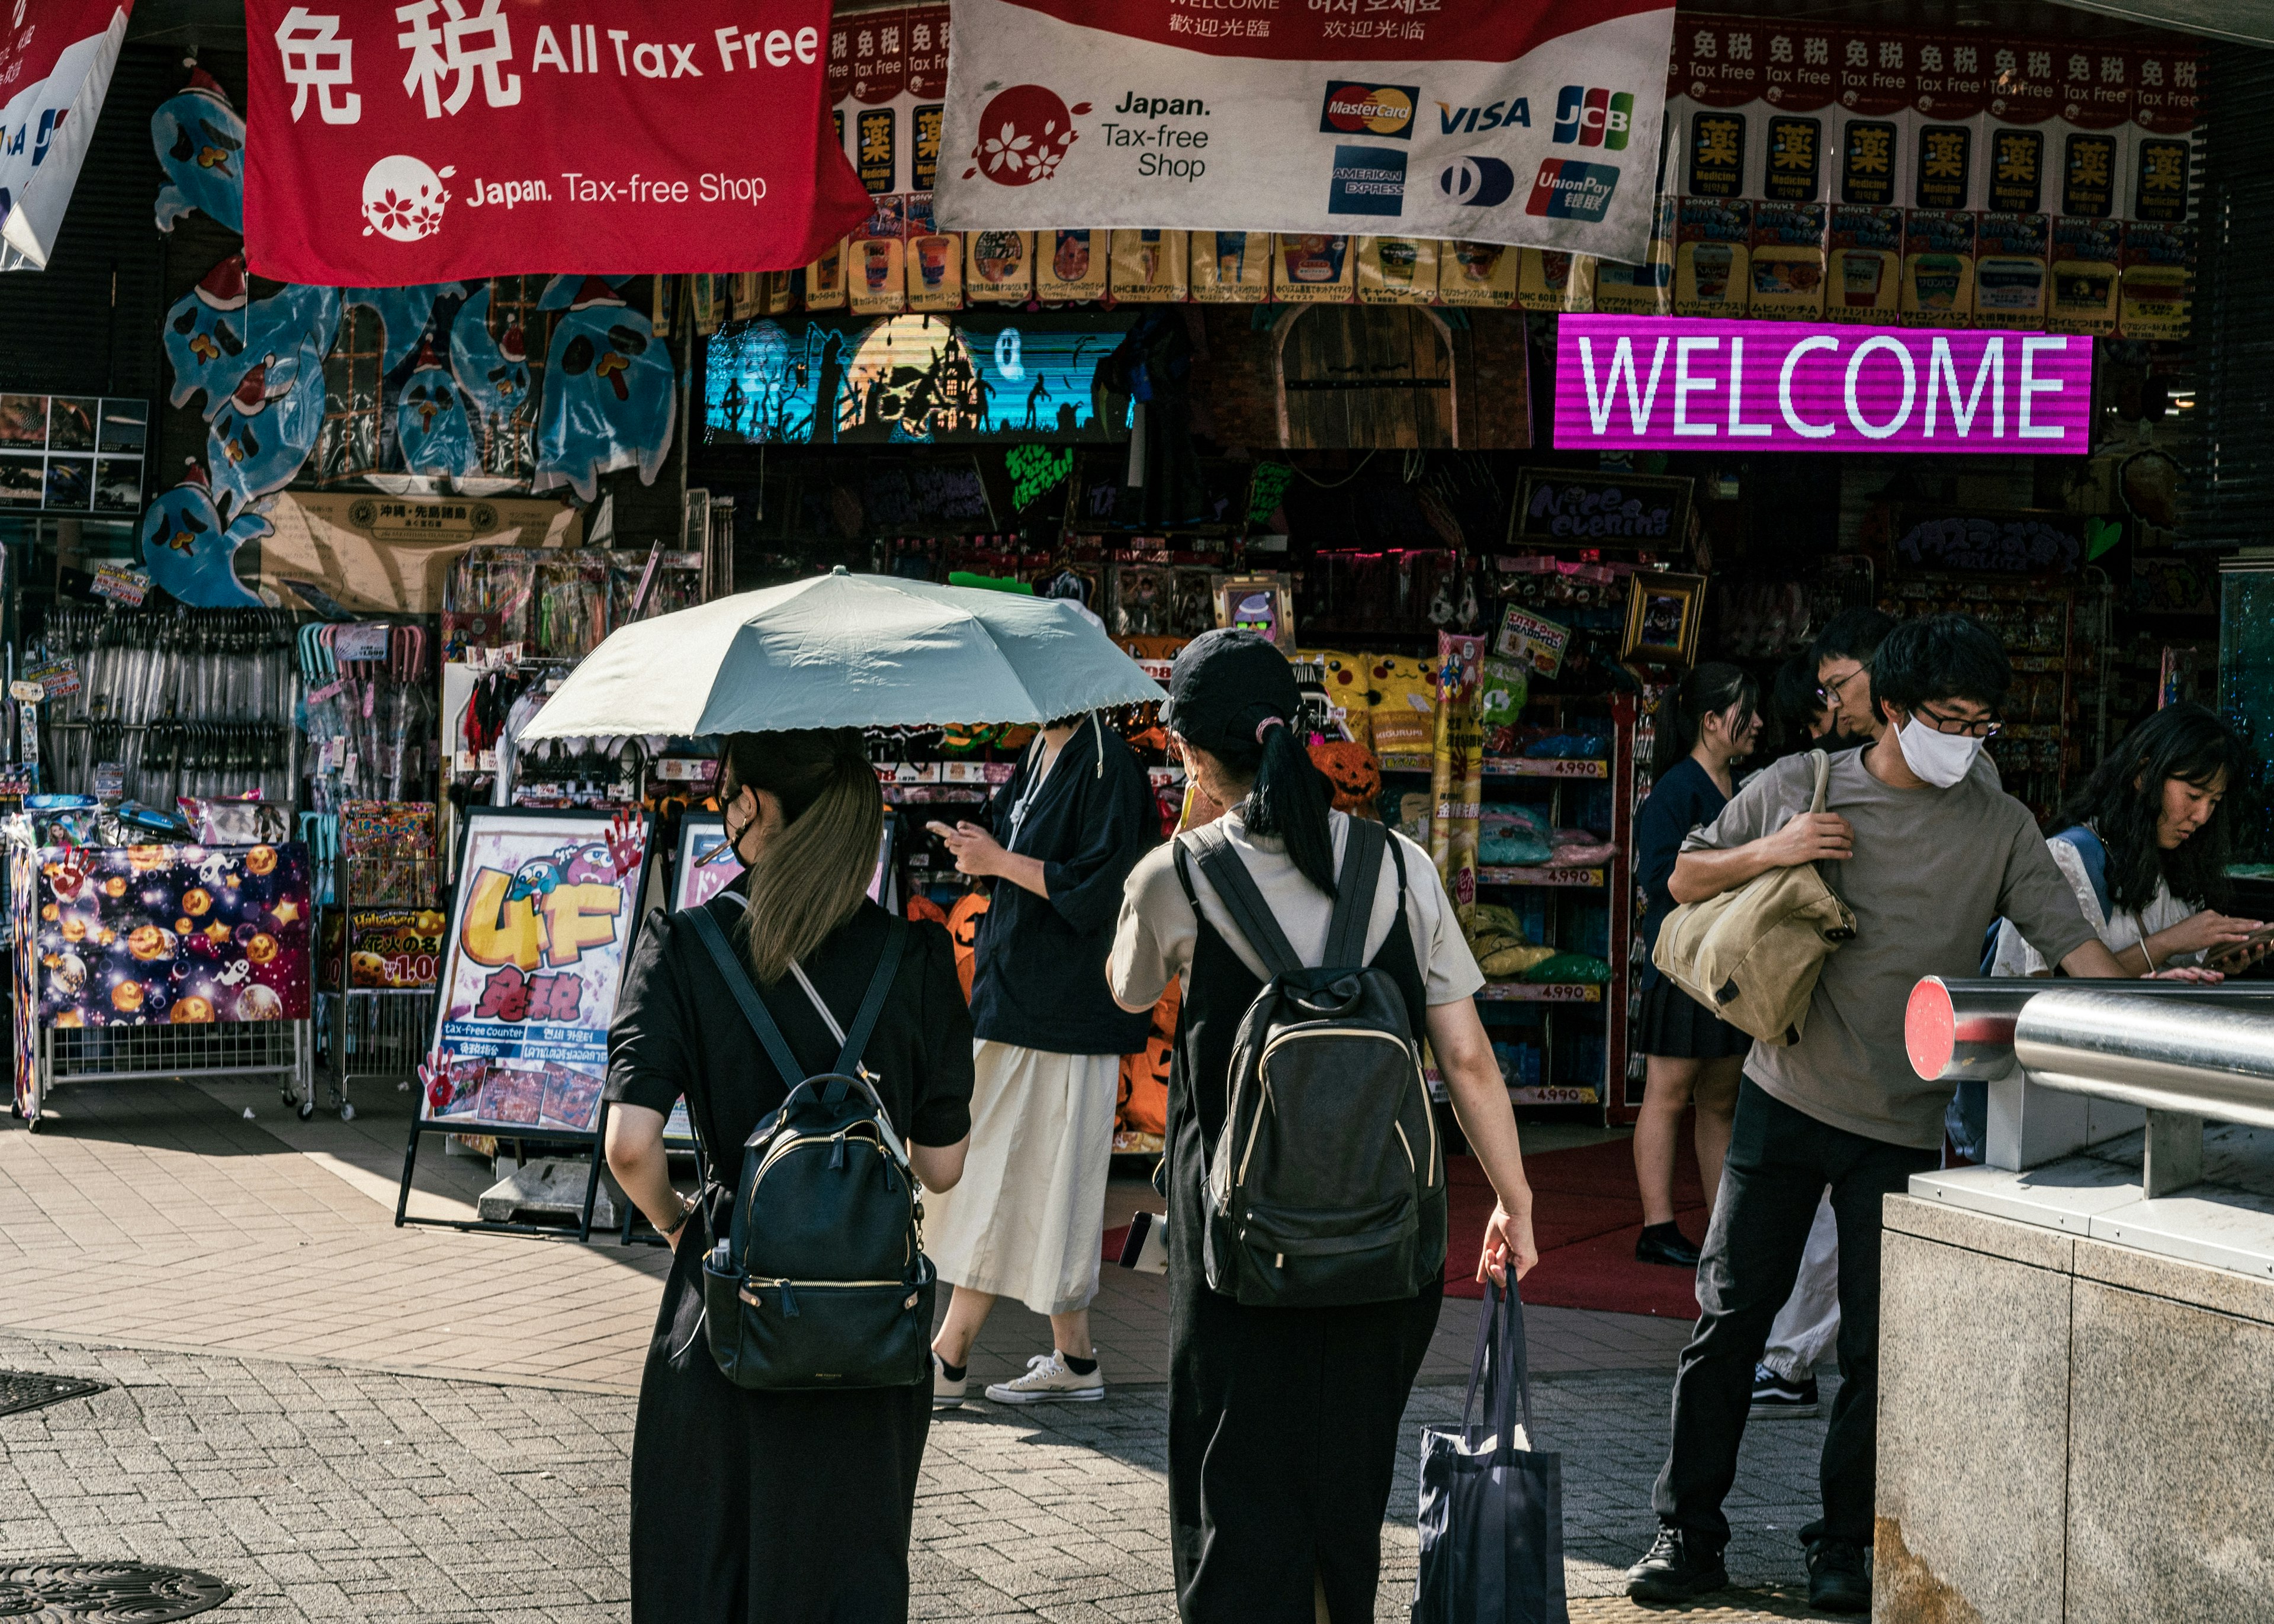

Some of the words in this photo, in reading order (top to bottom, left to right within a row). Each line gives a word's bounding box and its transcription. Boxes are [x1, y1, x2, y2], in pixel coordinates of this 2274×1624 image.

[1169, 13, 1271, 37] 歡迎光臨
[1322, 20, 1425, 40] 欢迎光临
[532, 25, 598, 73] All
[609, 29, 704, 79] Tax
[714, 25, 820, 72] Free
[857, 26, 900, 57] 免税
[1694, 30, 1752, 60] 免税
[1769, 35, 1828, 65] 免税
[275, 0, 521, 125] 免税
[909, 56, 930, 71] Tax
[1845, 40, 1903, 69] 免税
[1919, 44, 1978, 73] 免税
[1994, 48, 2051, 79] 免税
[855, 62, 873, 78] Tax
[876, 60, 901, 75] Free
[1690, 62, 1716, 78] Tax
[1721, 64, 1755, 80] Free
[1766, 66, 1791, 82] Tax
[1797, 68, 1831, 85] Free
[1841, 70, 1867, 86] Tax
[1872, 72, 1906, 89] Free
[2067, 54, 2124, 83] 免税
[2141, 59, 2196, 88] 免税
[1916, 76, 1942, 92] Tax
[1948, 77, 1980, 93] Free
[1990, 79, 2015, 95] Tax
[2063, 84, 2089, 100] Tax
[2095, 87, 2127, 103] Free
[1115, 92, 1211, 119] Japan.
[1329, 101, 1410, 119] MasterCard
[2137, 90, 2162, 105] Tax
[2167, 92, 2199, 107] Free
[1435, 97, 1531, 134] VISA
[862, 115, 890, 162] 薬
[1101, 124, 1209, 148] Tax-free
[1699, 120, 1739, 165] 薬
[1774, 124, 1814, 169] 薬
[1851, 128, 1890, 173] 薬
[1926, 133, 1964, 177] 薬
[1999, 136, 2037, 181] 薬
[862, 168, 890, 179] Medicine
[1138, 153, 1206, 182] Shop
[1333, 166, 1402, 181] AMERICAN
[2071, 142, 2109, 185] 薬
[2145, 146, 2183, 191] 薬
[1345, 182, 1404, 195] EXPRESS
[1539, 172, 1612, 202] UnionPay
[1696, 171, 1736, 182] Medicine
[1772, 175, 1811, 186] Medicine
[1849, 179, 1887, 189] Medicine
[467, 177, 552, 210] Japan.
[561, 172, 689, 203] Tax-free
[699, 172, 767, 207] Shop
[1923, 184, 1960, 194] Medicine
[1996, 186, 2034, 198] Medicine
[1520, 292, 1535, 301] DHC
[1903, 311, 1968, 321] サロンパス
[1578, 335, 2068, 439] WELCOME
[1376, 729, 1423, 739] KIGURUMI
[353, 912, 416, 931] Halloween
[460, 863, 624, 973] 4F
[445, 1022, 486, 1035] tax-free
